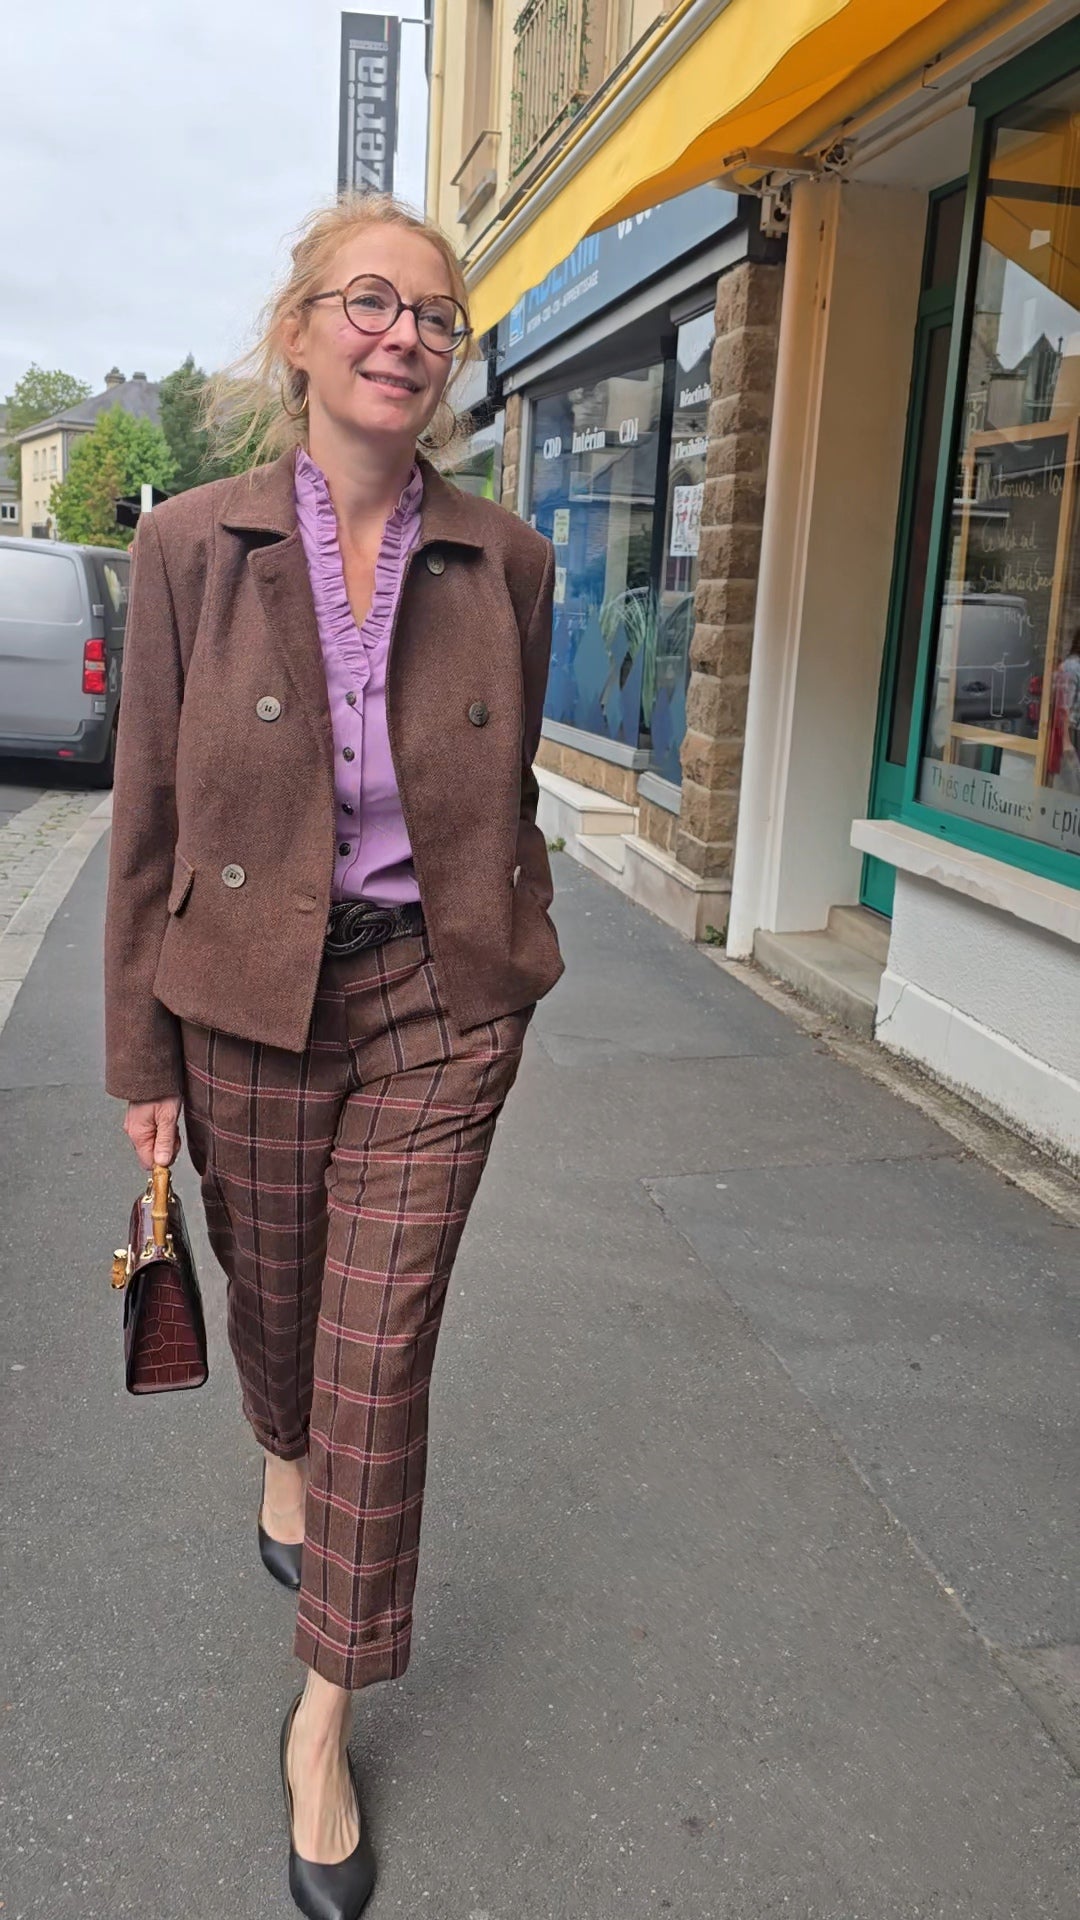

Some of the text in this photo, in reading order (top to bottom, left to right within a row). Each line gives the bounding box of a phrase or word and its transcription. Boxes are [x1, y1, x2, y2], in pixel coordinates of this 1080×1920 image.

[543, 417, 639, 460] CDD Intérim CDI
[962, 778, 976, 805] et
